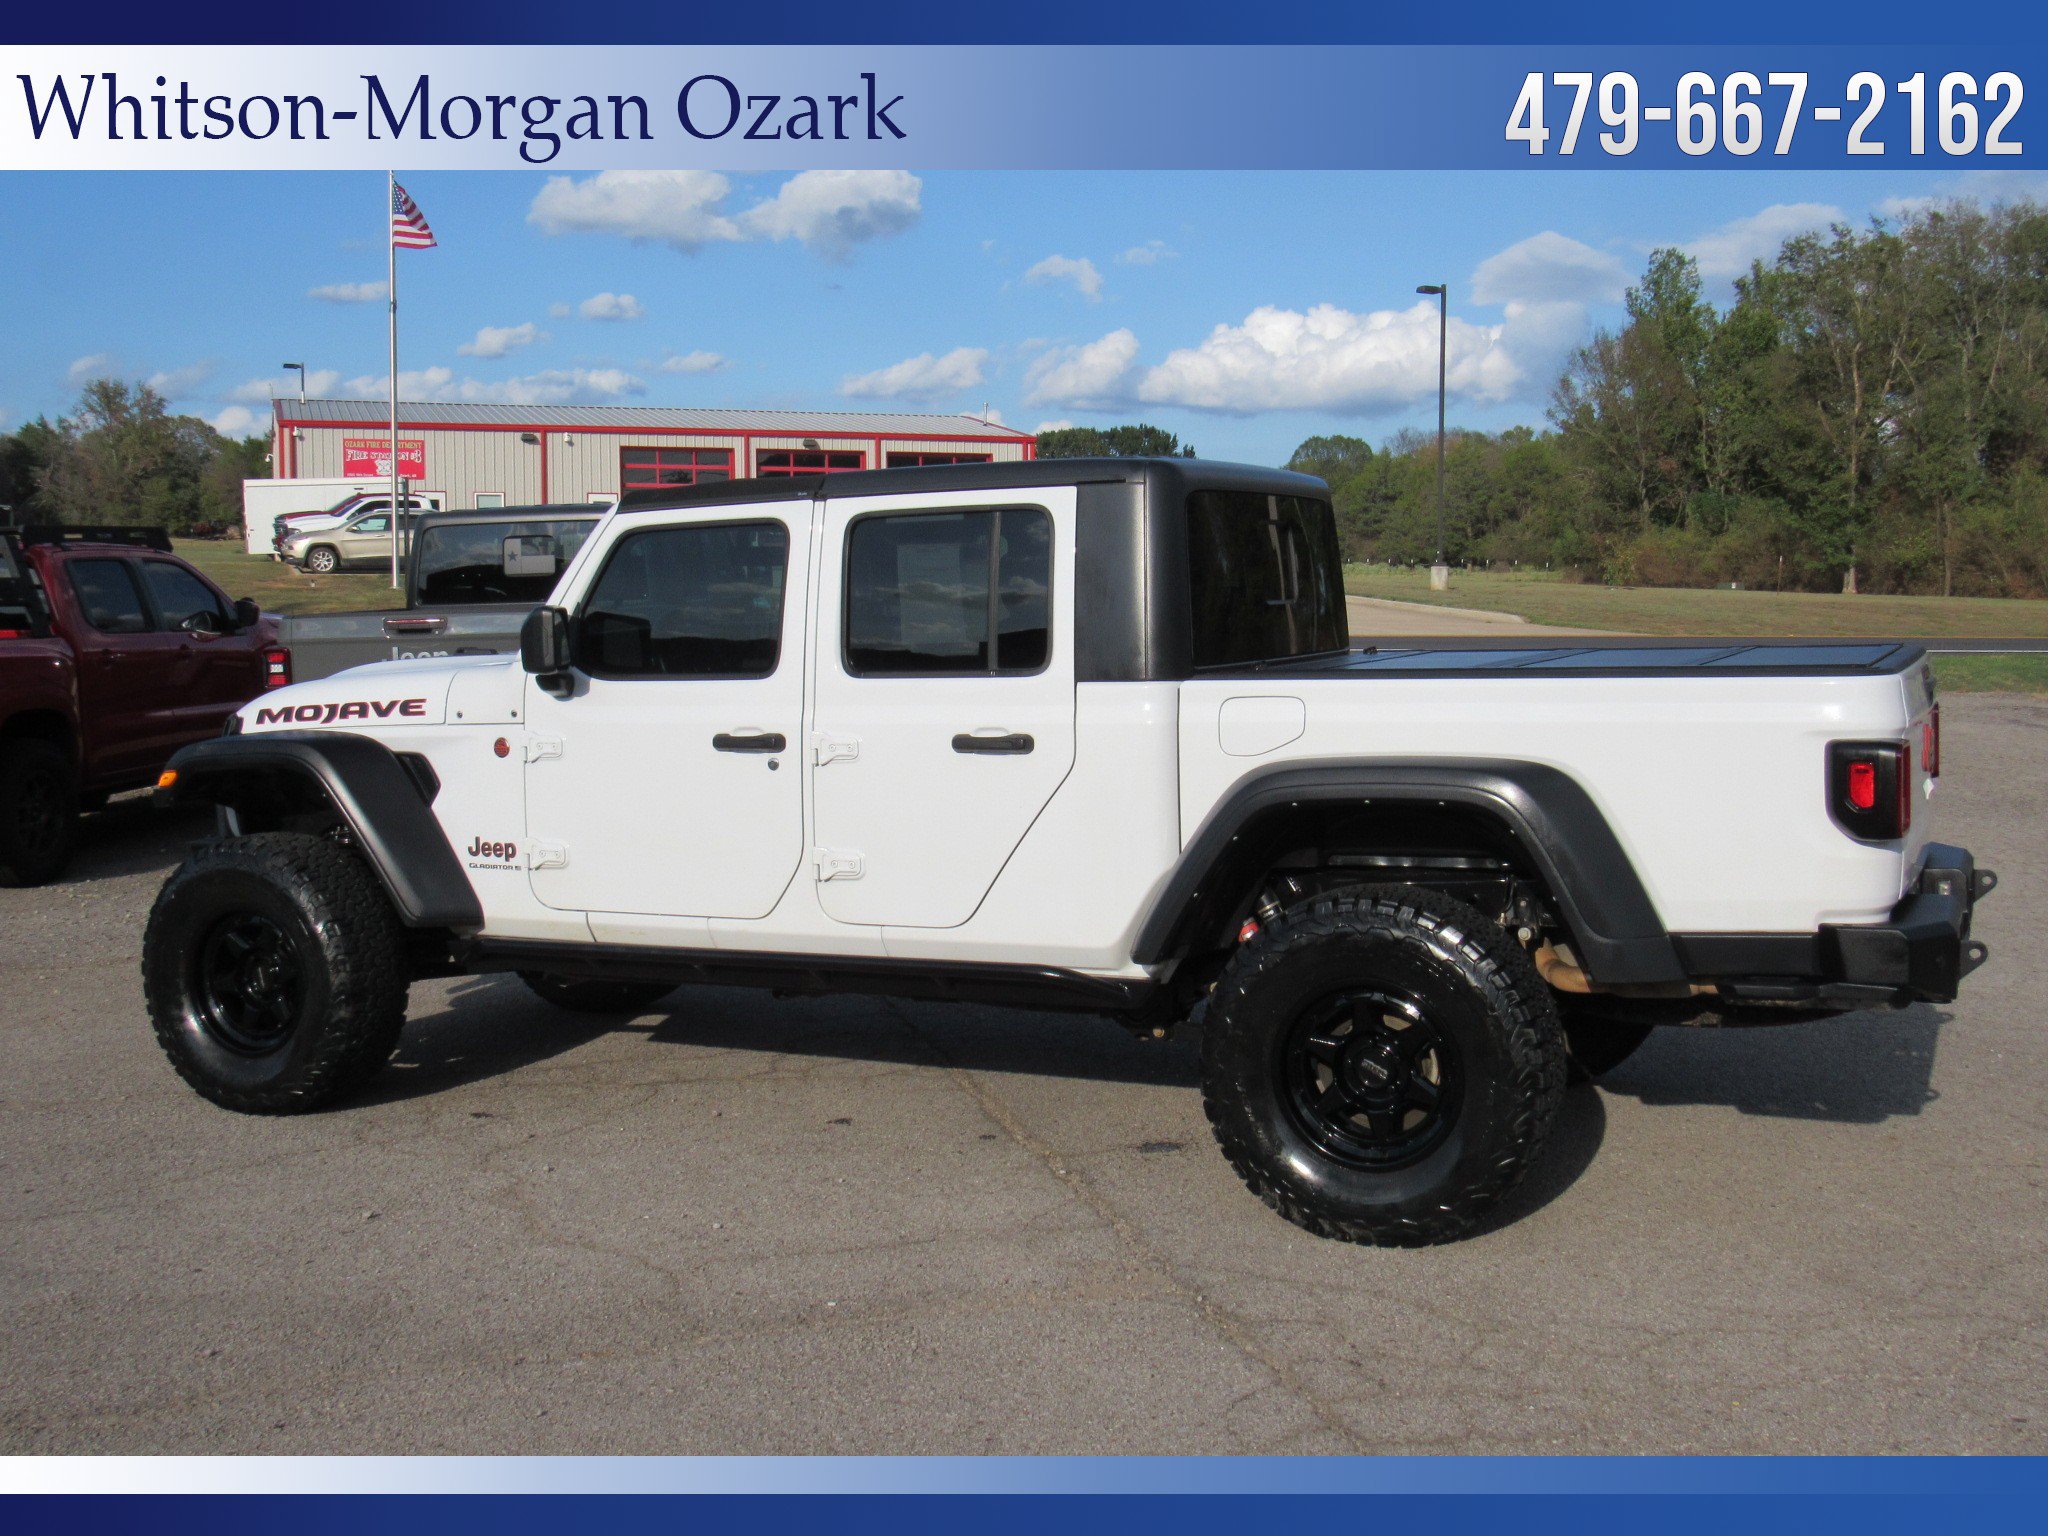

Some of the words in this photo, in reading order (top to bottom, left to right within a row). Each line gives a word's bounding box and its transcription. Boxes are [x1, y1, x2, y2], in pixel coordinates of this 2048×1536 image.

[346, 449, 369, 461] FIRE
[370, 451, 409, 461] STATON
[256, 698, 427, 725] MOJAVE
[468, 836, 516, 862] Jeep
